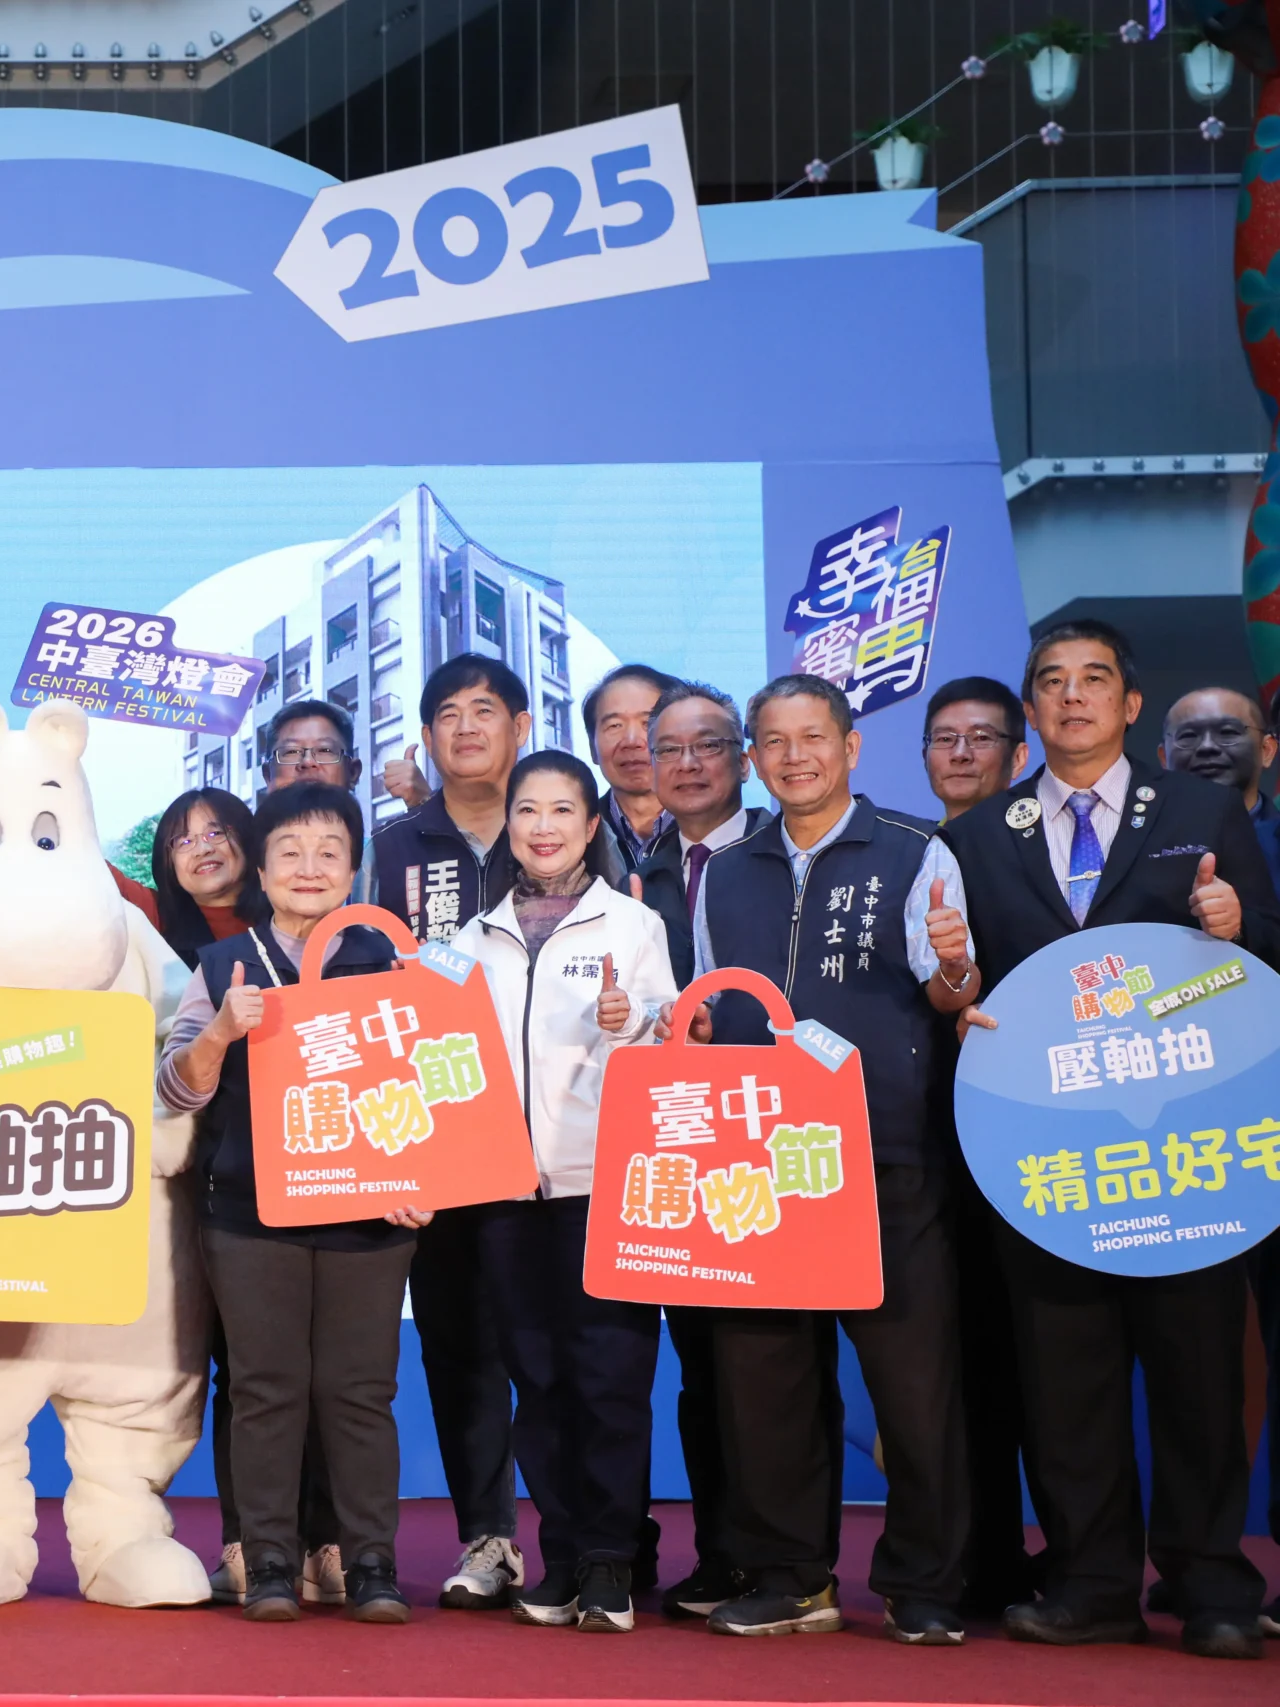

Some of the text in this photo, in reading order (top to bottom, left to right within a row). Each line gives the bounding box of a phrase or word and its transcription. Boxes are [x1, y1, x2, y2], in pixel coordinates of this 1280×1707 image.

[322, 144, 675, 310] 2025
[45, 609, 166, 648] 2026
[36, 639, 255, 698] 中臺灣燈會
[28, 673, 198, 708] CENTRAL TAIWAN
[114, 702, 207, 727] FESTIVAL
[820, 885, 854, 983] 劉士州
[857, 876, 882, 971] 臺中市議員
[427, 947, 469, 974] SALE
[1070, 953, 1125, 992] 臺中
[1205, 965, 1244, 991] SALE
[1072, 965, 1155, 1022] 購物節
[293, 998, 419, 1078] 臺中
[803, 1027, 845, 1060] SALE
[1047, 1023, 1214, 1094] 壓軸抽
[283, 1032, 487, 1156] 購物節
[648, 1075, 782, 1147] 臺中
[285, 1167, 356, 1182] TAICHUNG
[286, 1179, 420, 1197] SHOPPING FESTIVAL
[620, 1122, 844, 1244] 購物節
[1089, 1213, 1170, 1237] TAICHUNG
[1092, 1220, 1246, 1253] SHOPPING FESTIVAL
[617, 1242, 691, 1261] TAICHUNG
[615, 1258, 755, 1285] SHOPPING FESTIVAL
